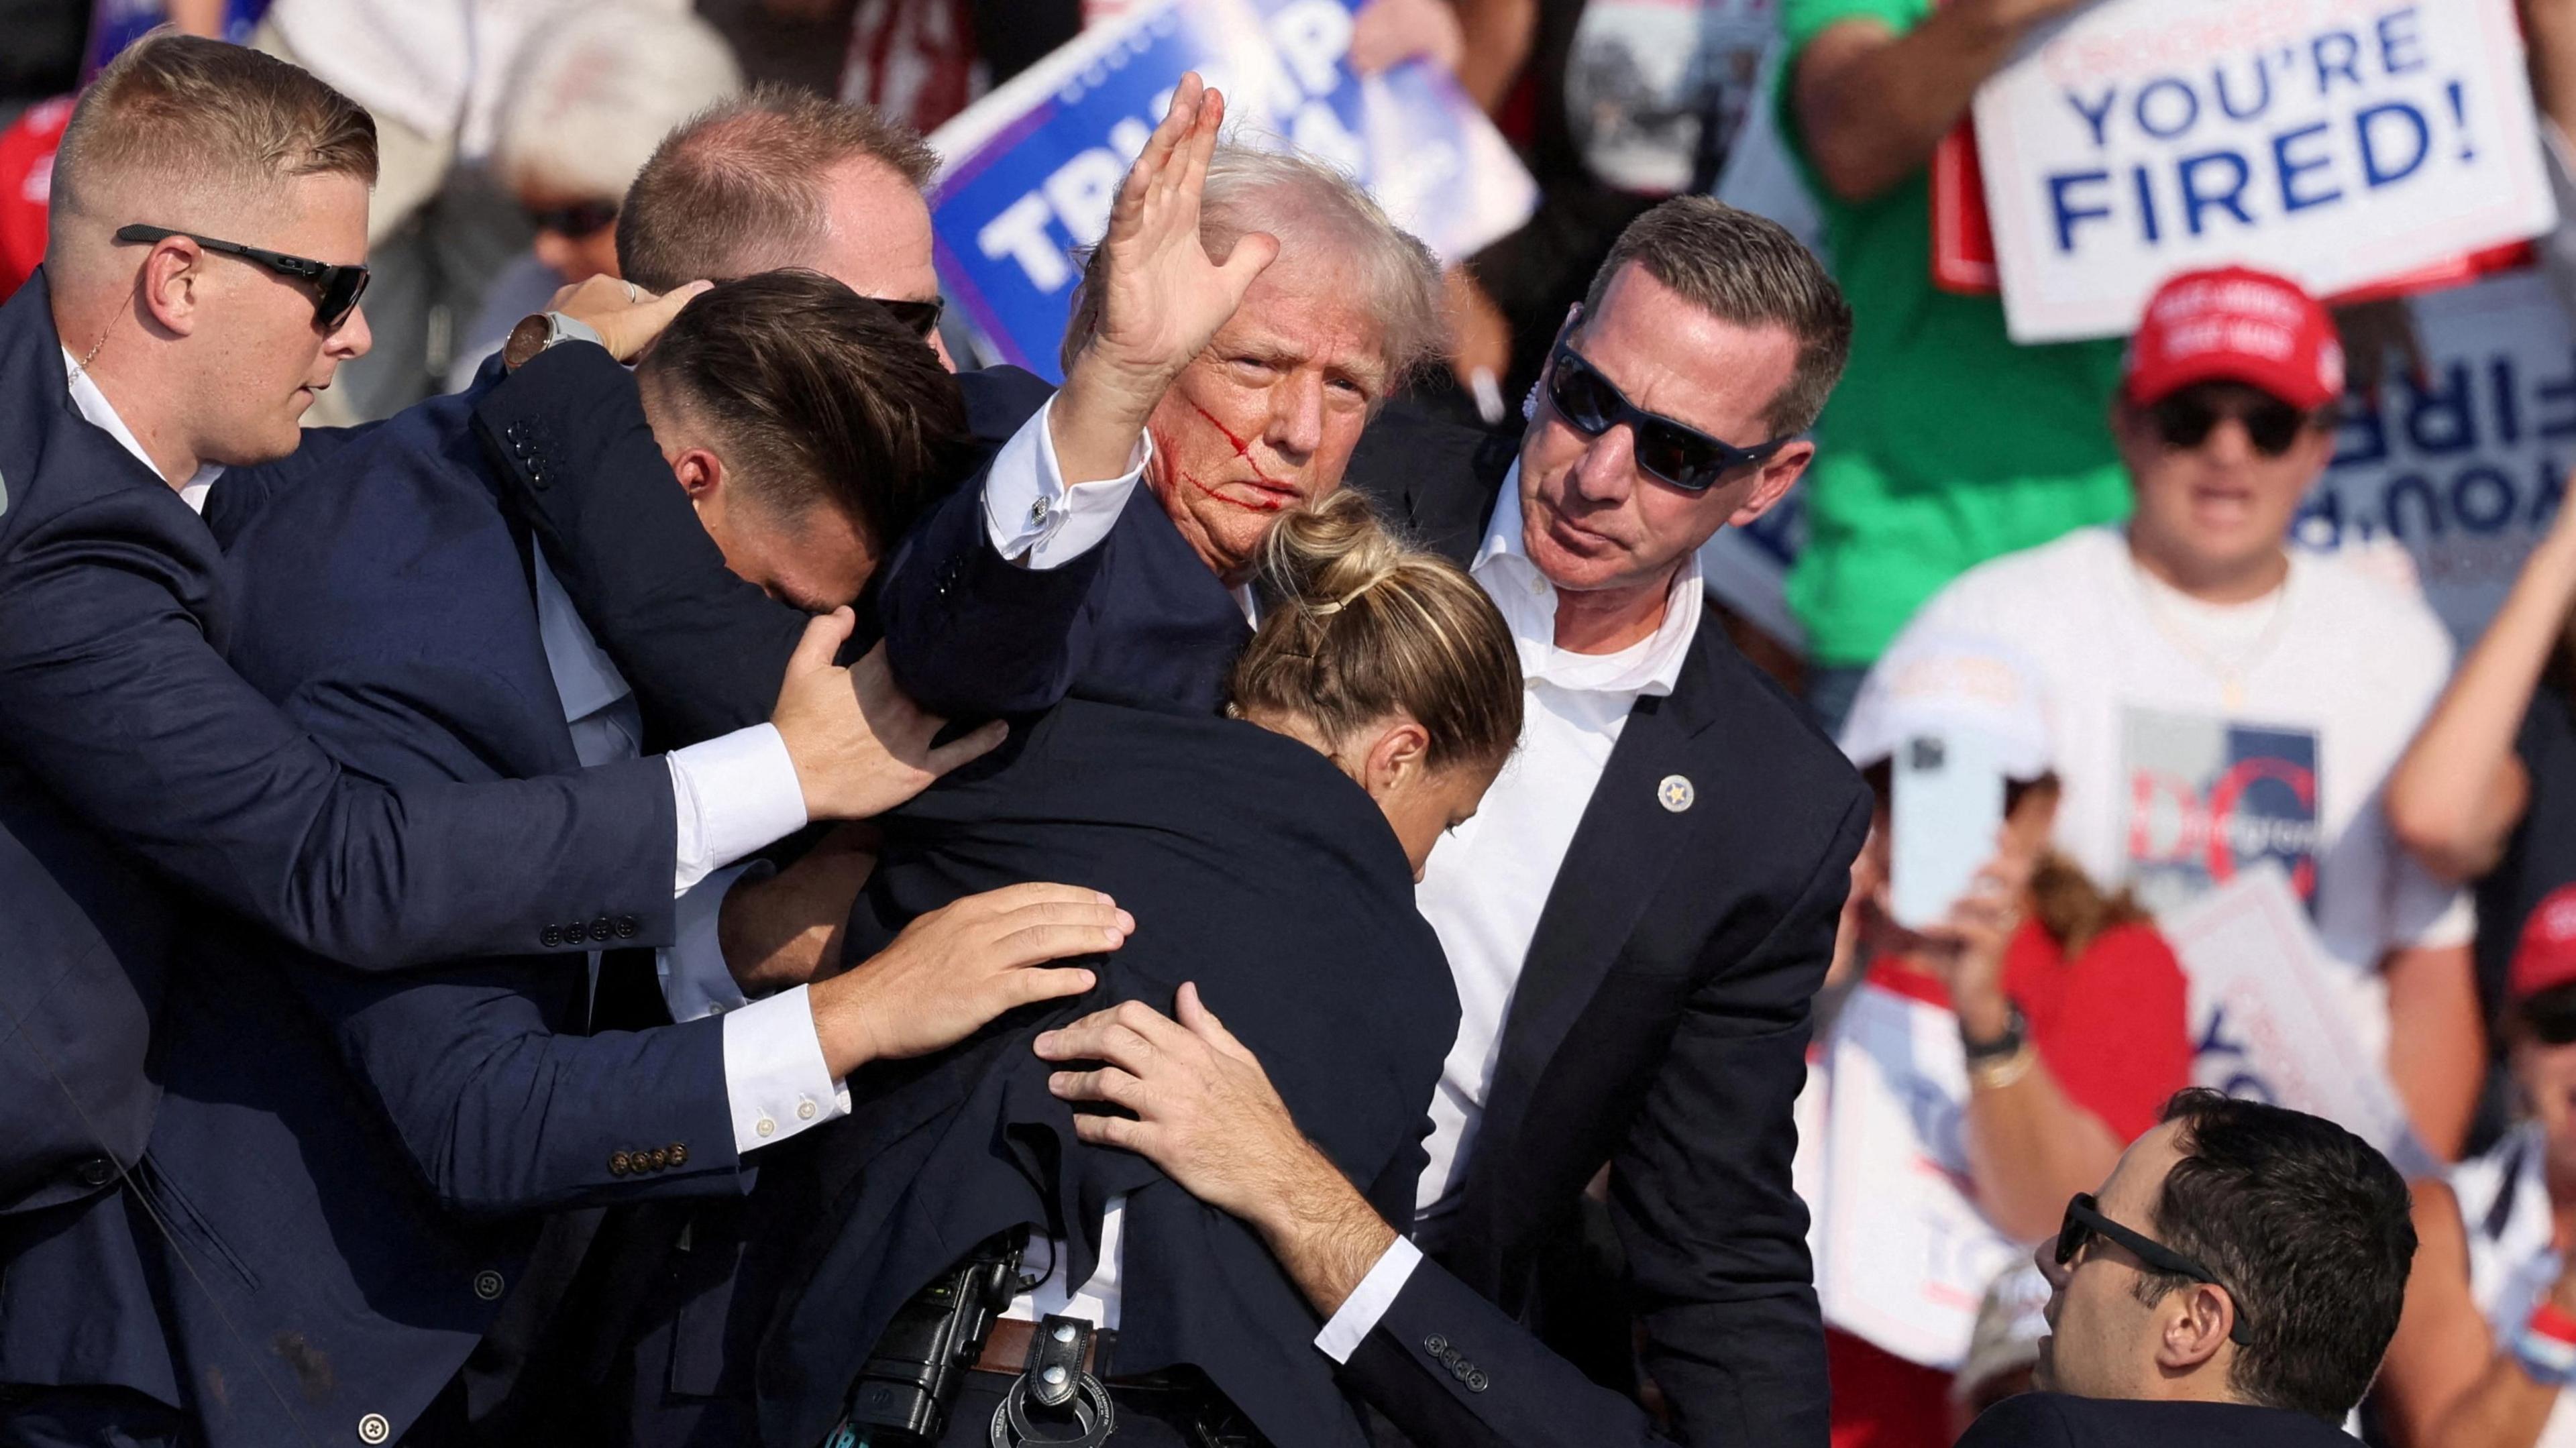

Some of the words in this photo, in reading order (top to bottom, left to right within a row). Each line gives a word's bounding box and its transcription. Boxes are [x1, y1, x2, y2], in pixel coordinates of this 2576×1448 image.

[975, 0, 1354, 294] TRMP
[2069, 6, 2427, 148] YOU'RE
[2047, 80, 2475, 253] FIRED!
[2290, 455, 2564, 550] YOU'R
